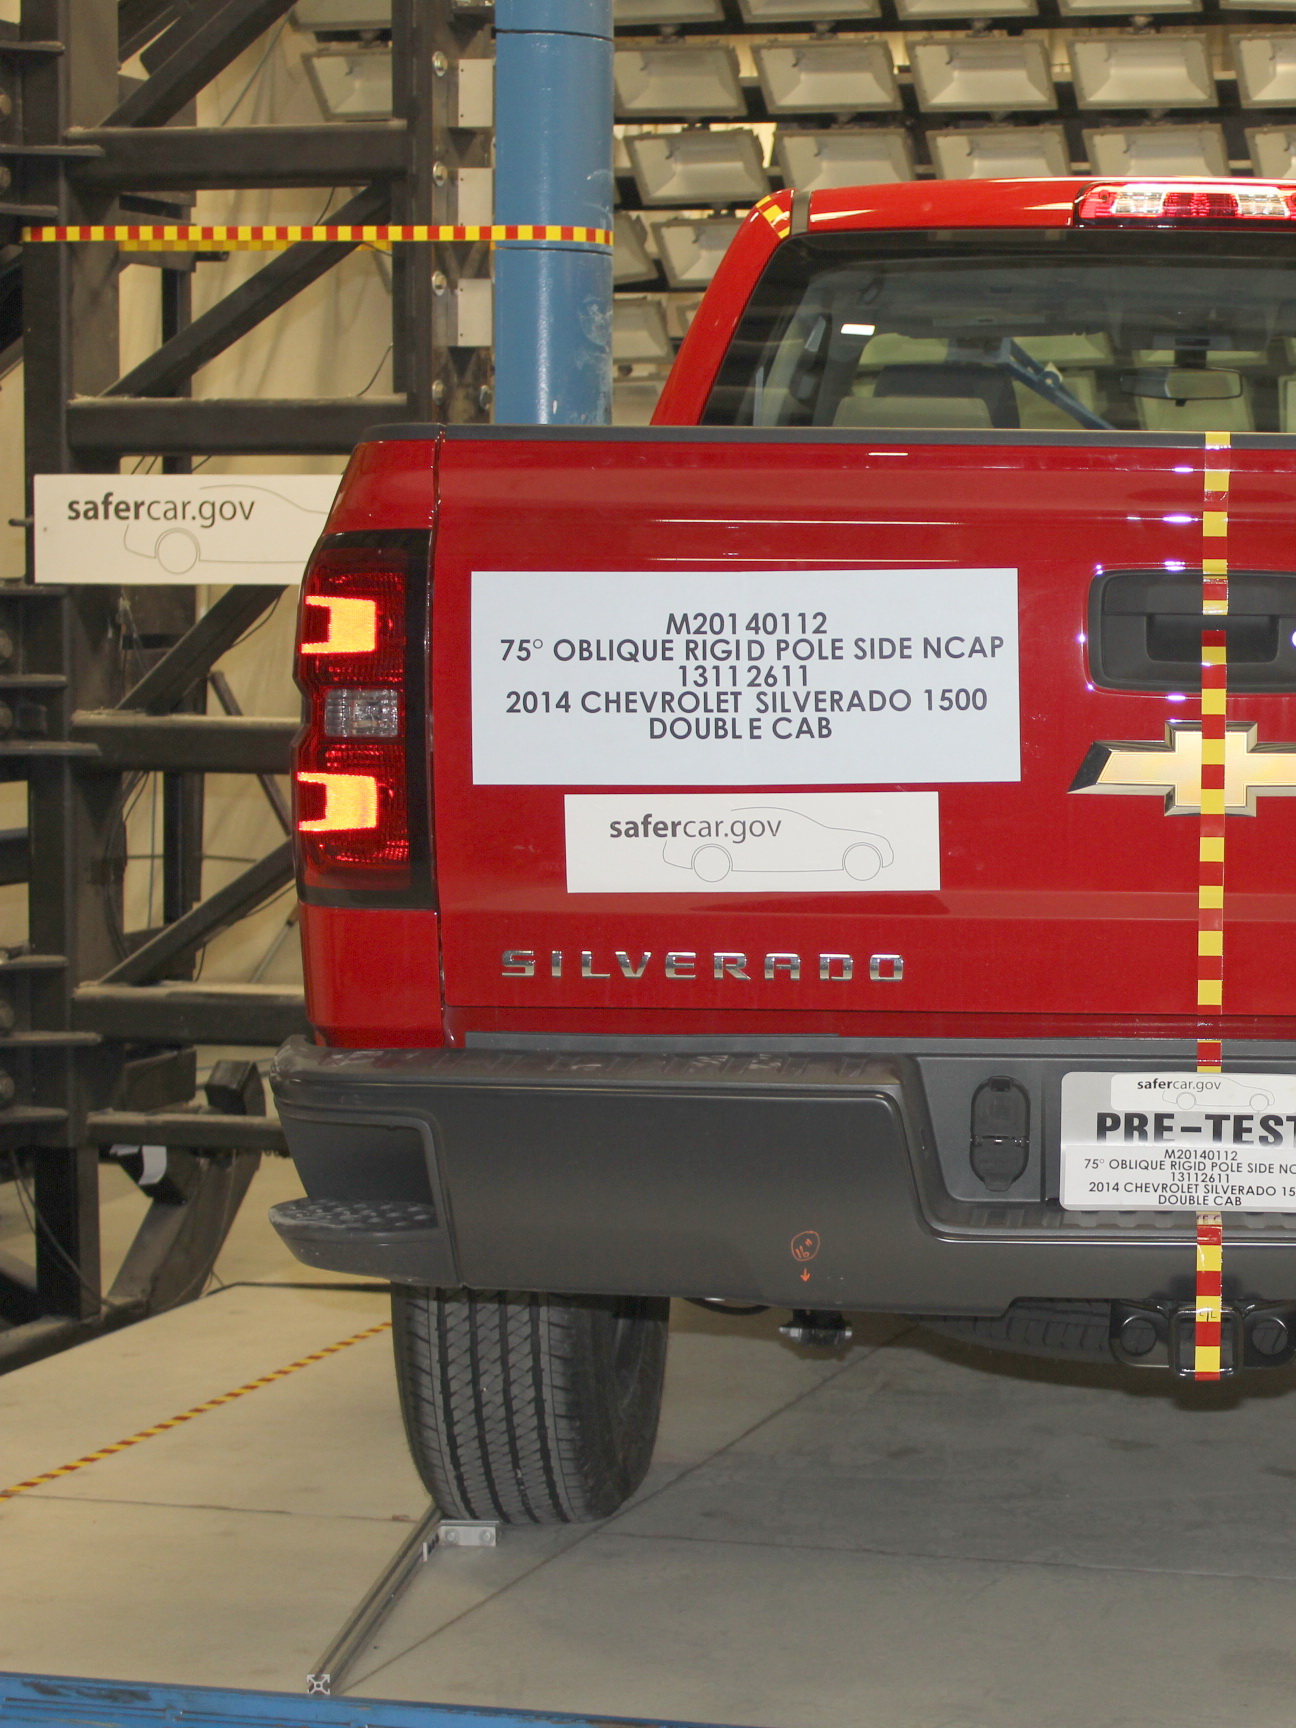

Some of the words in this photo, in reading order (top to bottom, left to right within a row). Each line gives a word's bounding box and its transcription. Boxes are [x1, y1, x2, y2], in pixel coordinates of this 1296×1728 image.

[67, 491, 255, 529] safercar.gov
[665, 612, 828, 636] M20140112
[500, 638, 544, 662] 75°
[553, 638, 674, 662] OBLIQUE
[685, 638, 765, 662] RIGID
[776, 638, 844, 662] POLE
[853, 637, 912, 661] SIDE
[923, 636, 1004, 659] NCAP
[678, 664, 808, 688] 13112611
[505, 690, 572, 714] 2014
[580, 690, 743, 714] CHEVROLET
[755, 688, 912, 714] SILVERADO
[924, 687, 988, 712] 1500
[649, 716, 762, 740] DOUBLE
[771, 716, 833, 740] CAB
[609, 813, 782, 844] safercar.gov
[500, 949, 906, 982] SILVERADO
[1136, 1078, 1222, 1093] safercar.gov
[1084, 1158, 1105, 1170] 75°
[1108, 1159, 1166, 1172] OBLIQUE
[1170, 1160, 1207, 1172] RIGID
[1211, 1162, 1244, 1173] POLE
[1247, 1162, 1275, 1174] SIDE
[1163, 1148, 1239, 1161] M20140112
[1088, 1182, 1120, 1193] 2014
[1123, 1182, 1199, 1194] CHEVROLET
[1203, 1184, 1277, 1196] SILVERADO
[1170, 1173, 1230, 1184] 13112611
[1158, 1194, 1210, 1206] DOUBLE
[1213, 1195, 1242, 1207] CAB
